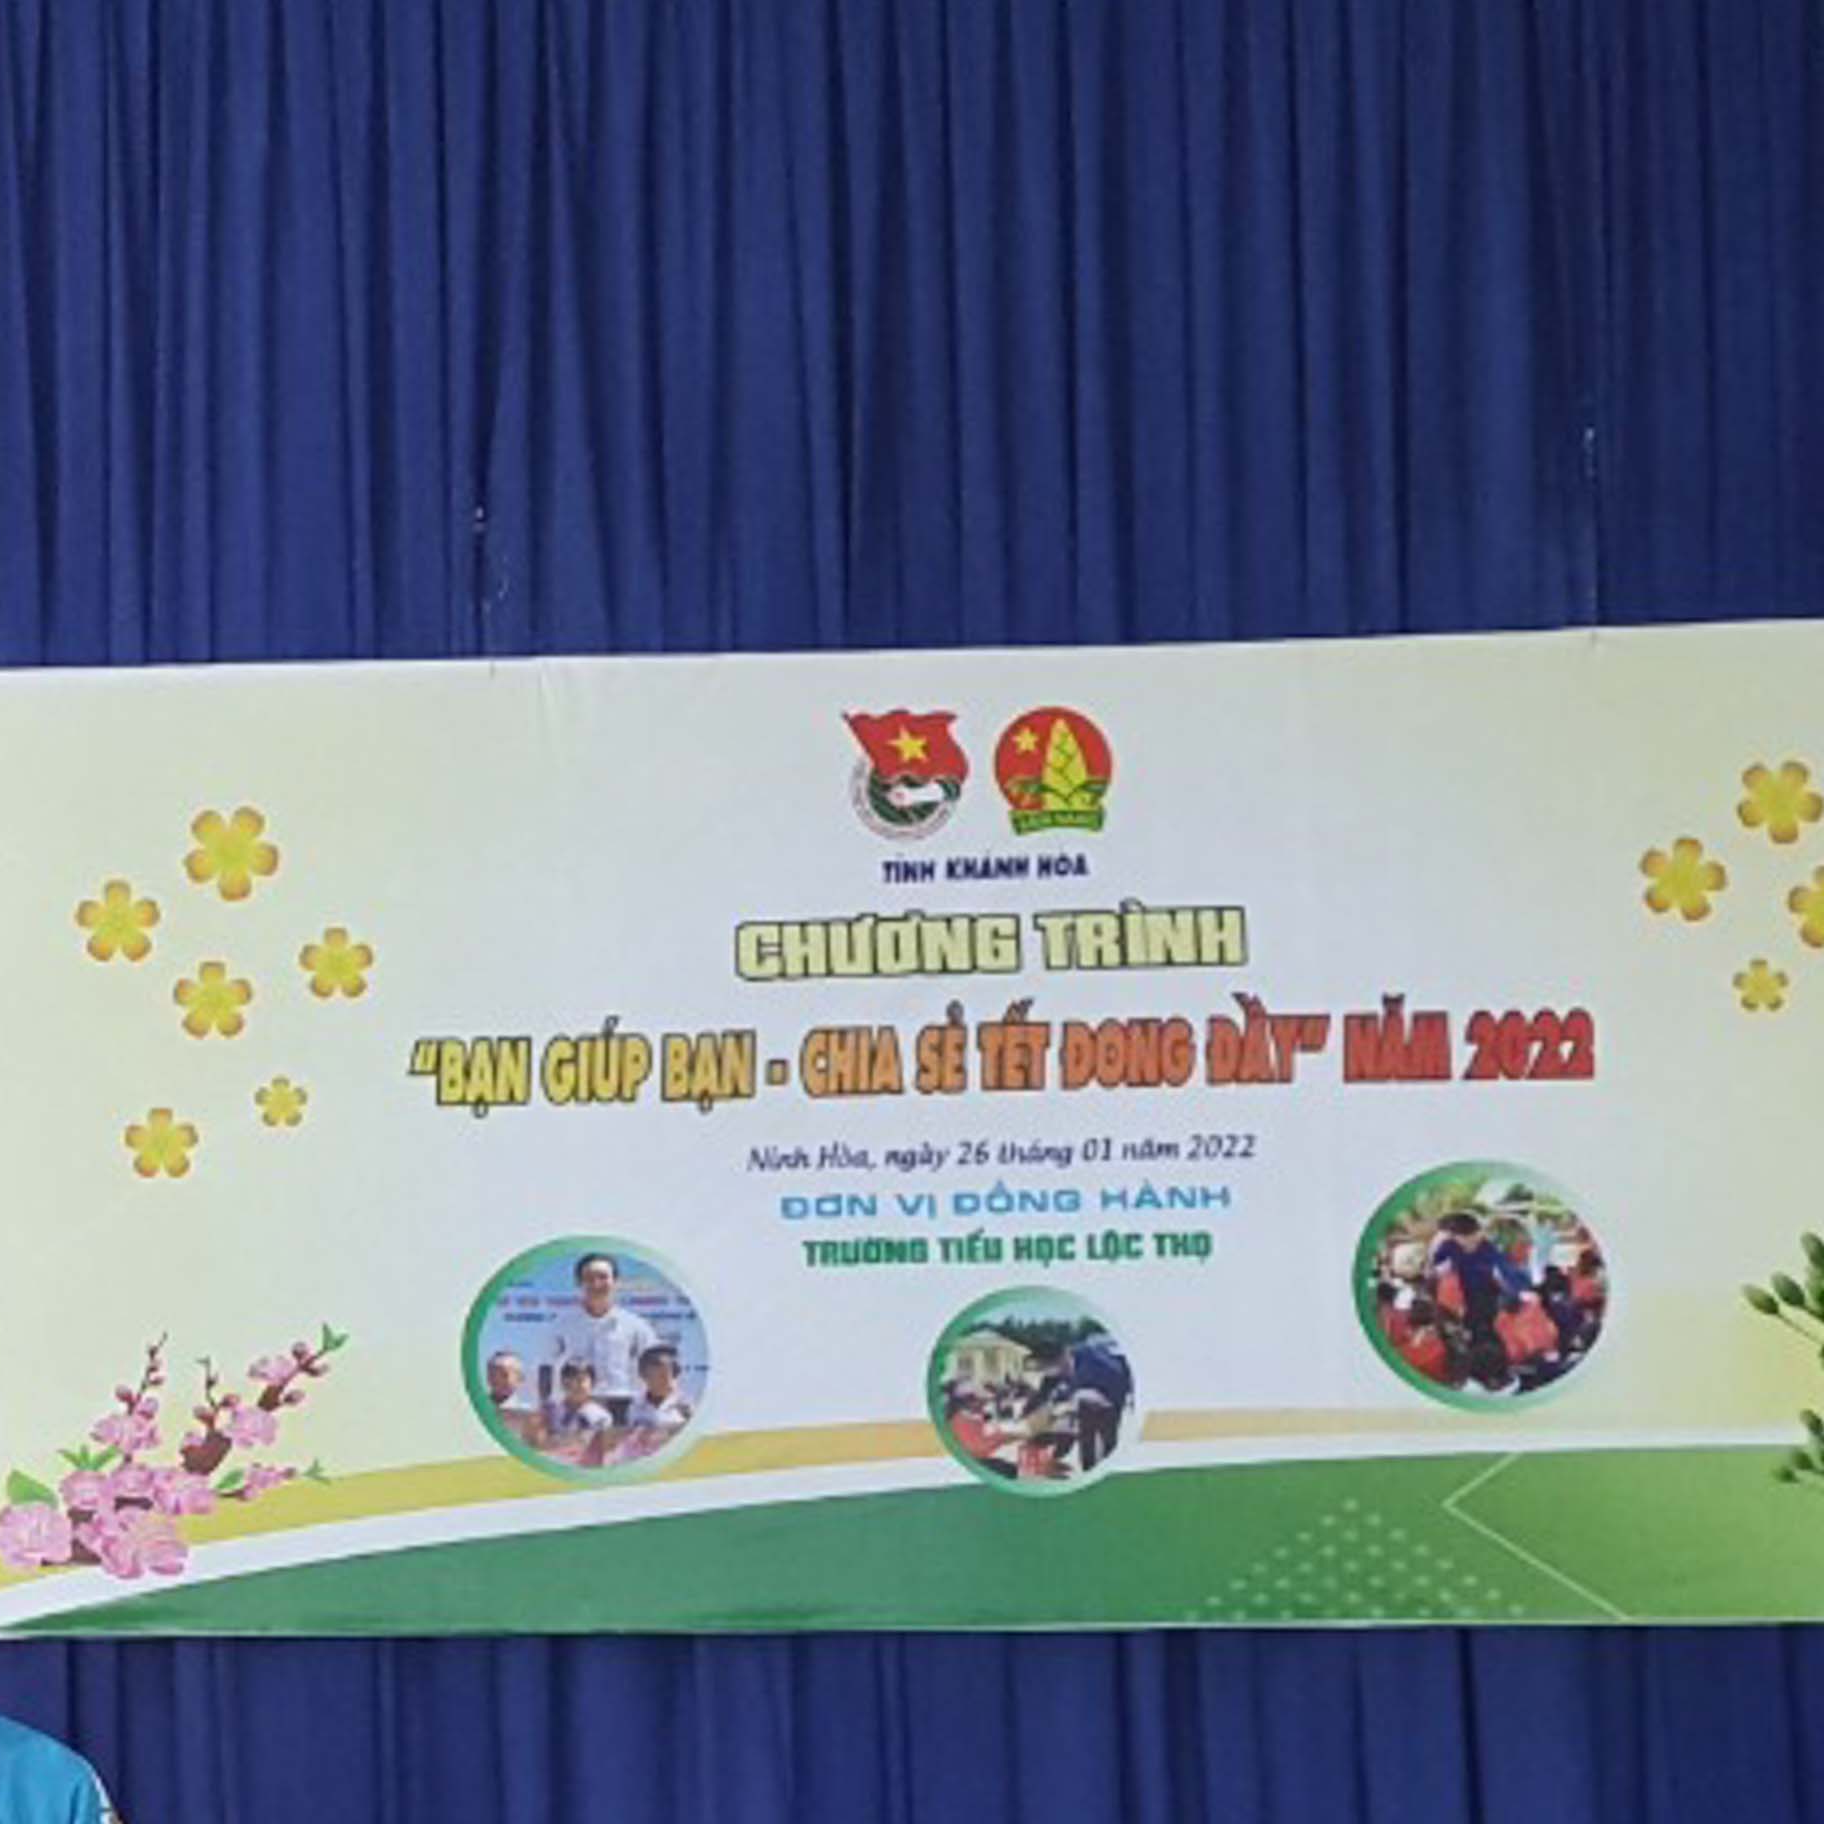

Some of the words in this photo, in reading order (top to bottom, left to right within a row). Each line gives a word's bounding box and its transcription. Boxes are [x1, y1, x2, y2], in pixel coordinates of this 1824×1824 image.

[945, 848, 1031, 881] KHÁNH
[735, 908, 1021, 981] CHƯƠNG
[1033, 897, 1247, 972] TRÌNH
[541, 1016, 652, 1102] GIÚP
[661, 1028, 756, 1114] BẠN
[799, 1025, 905, 1099] CHIA
[914, 999, 968, 1096] SẺ
[977, 997, 1052, 1092] TẾT
[1343, 993, 1452, 1084] NĂM
[1462, 1008, 1596, 1082] 2022
[747, 1145, 809, 1172] Ninh
[884, 1142, 953, 1173] ngày
[956, 1140, 991, 1166] 26
[997, 1137, 1074, 1169] tháng
[1081, 1137, 1113, 1162] 01
[1120, 1136, 1181, 1161] năm
[1186, 1133, 1258, 1160] 2022
[1012, 1233, 1077, 1269] HỌC
